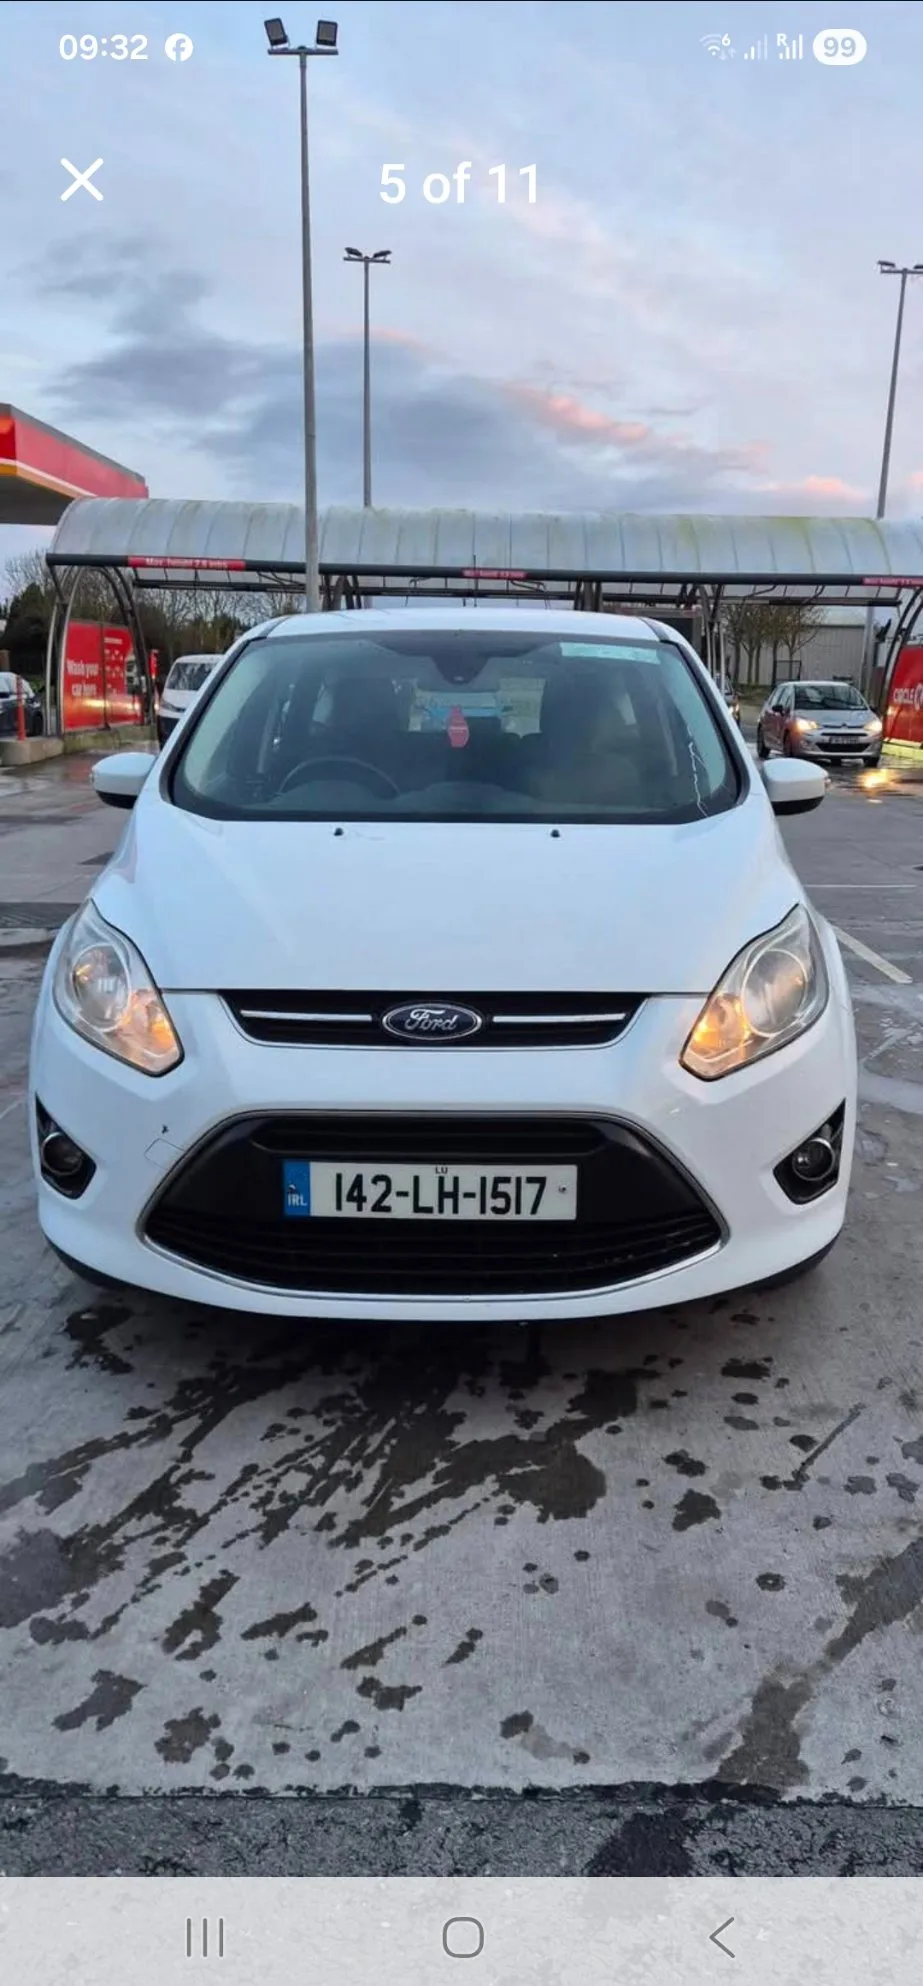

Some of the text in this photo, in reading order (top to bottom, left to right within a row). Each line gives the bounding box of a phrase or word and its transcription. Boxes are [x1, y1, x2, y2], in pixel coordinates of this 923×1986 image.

[404, 1008, 459, 1031] Ford
[287, 1193, 308, 1206] IRL
[335, 1173, 547, 1215] 142-LH-1517
